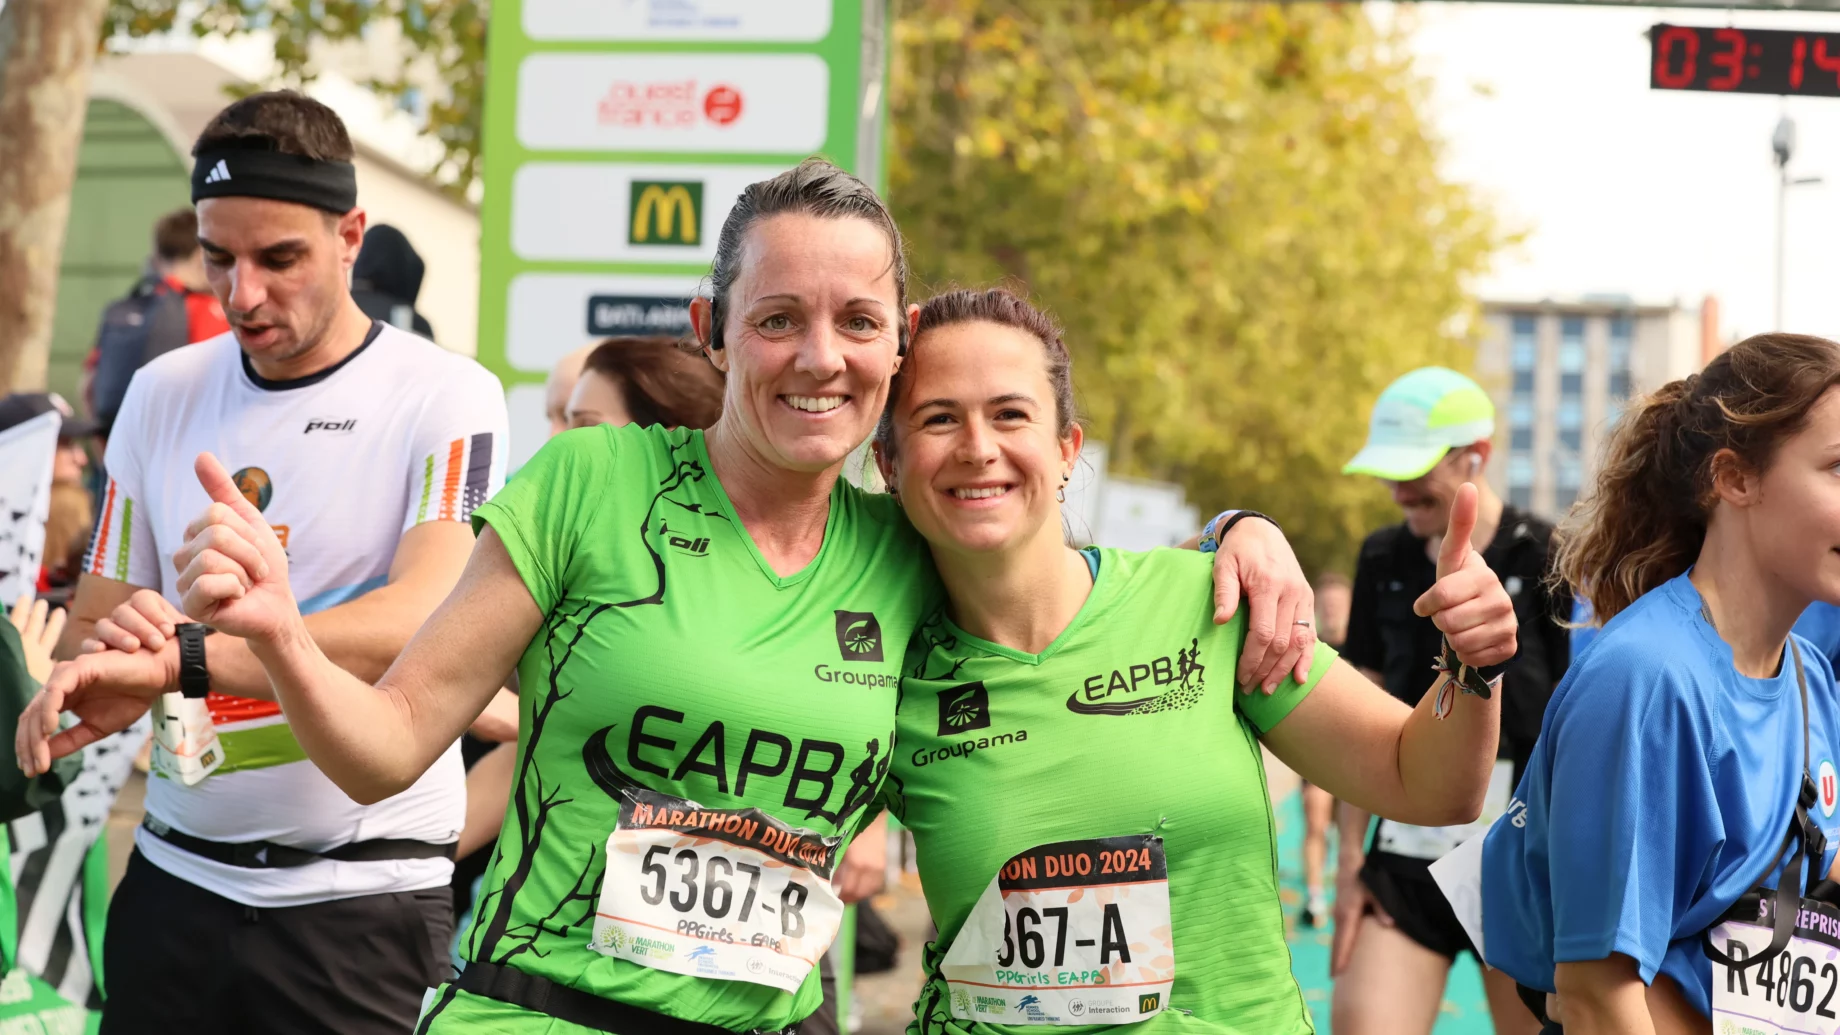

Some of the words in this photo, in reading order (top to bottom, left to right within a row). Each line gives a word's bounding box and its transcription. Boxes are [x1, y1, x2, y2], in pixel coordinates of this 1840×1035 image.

[814, 664, 897, 690] Groupama
[1084, 655, 1174, 701] EAPB
[627, 705, 845, 811] EAPB
[911, 729, 1028, 767] Groupama
[631, 802, 759, 841] MARATHON
[760, 826, 800, 859] DUO
[1045, 853, 1092, 878] DUO
[1100, 848, 1152, 874] 2024
[640, 845, 808, 939] 5367-B
[632, 944, 648, 956] VERT
[635, 936, 676, 953] MARATHON
[996, 970, 1051, 985] PPGirls
[1088, 1006, 1131, 1014] Interaction
